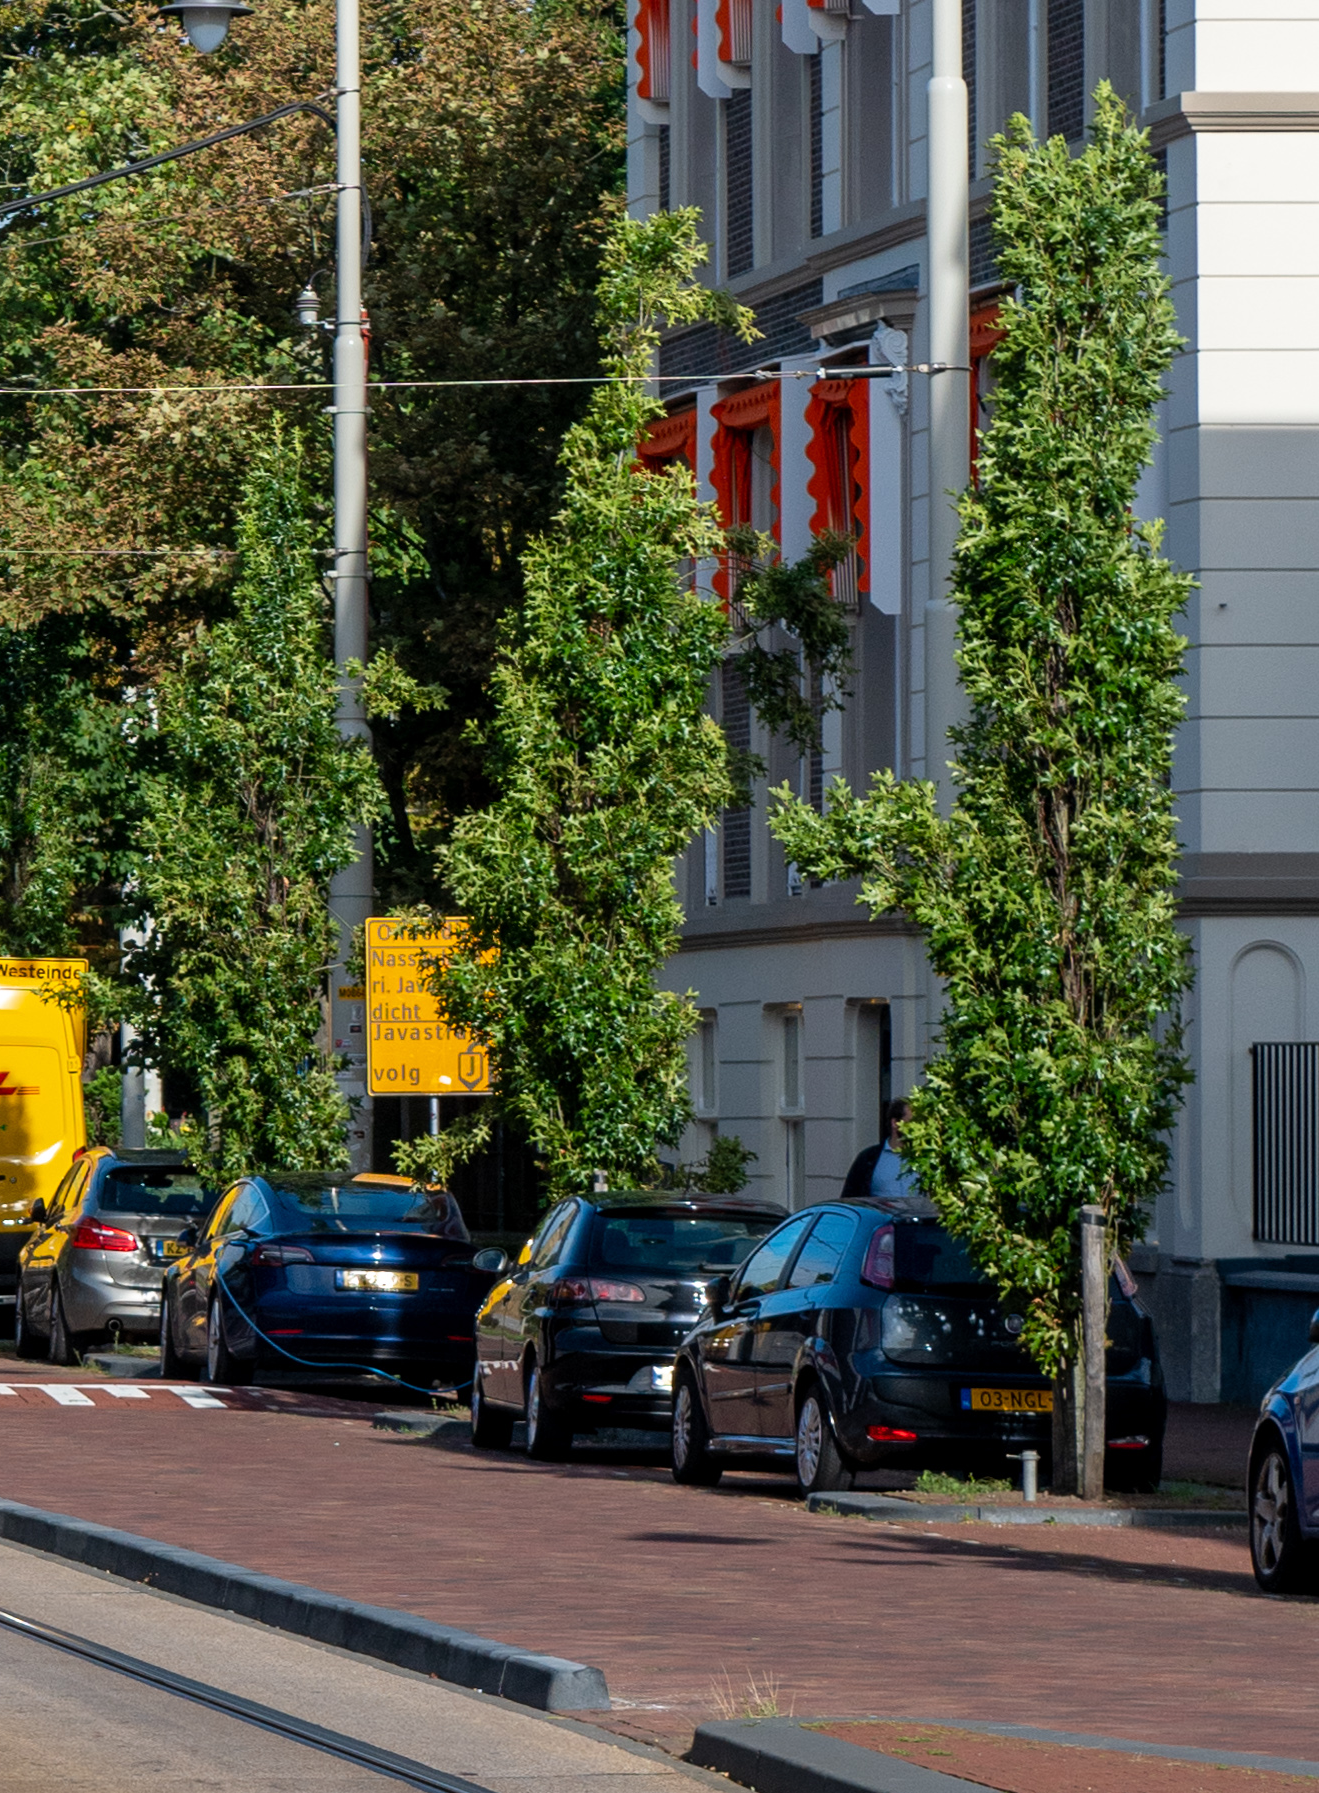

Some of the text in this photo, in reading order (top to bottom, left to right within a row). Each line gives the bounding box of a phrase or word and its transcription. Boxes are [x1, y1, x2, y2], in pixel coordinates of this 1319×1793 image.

[372, 977, 391, 994] ri.
[372, 1003, 421, 1021] dicht
[374, 1064, 420, 1086] volg
[980, 1391, 1053, 1408] 03-NGL-
